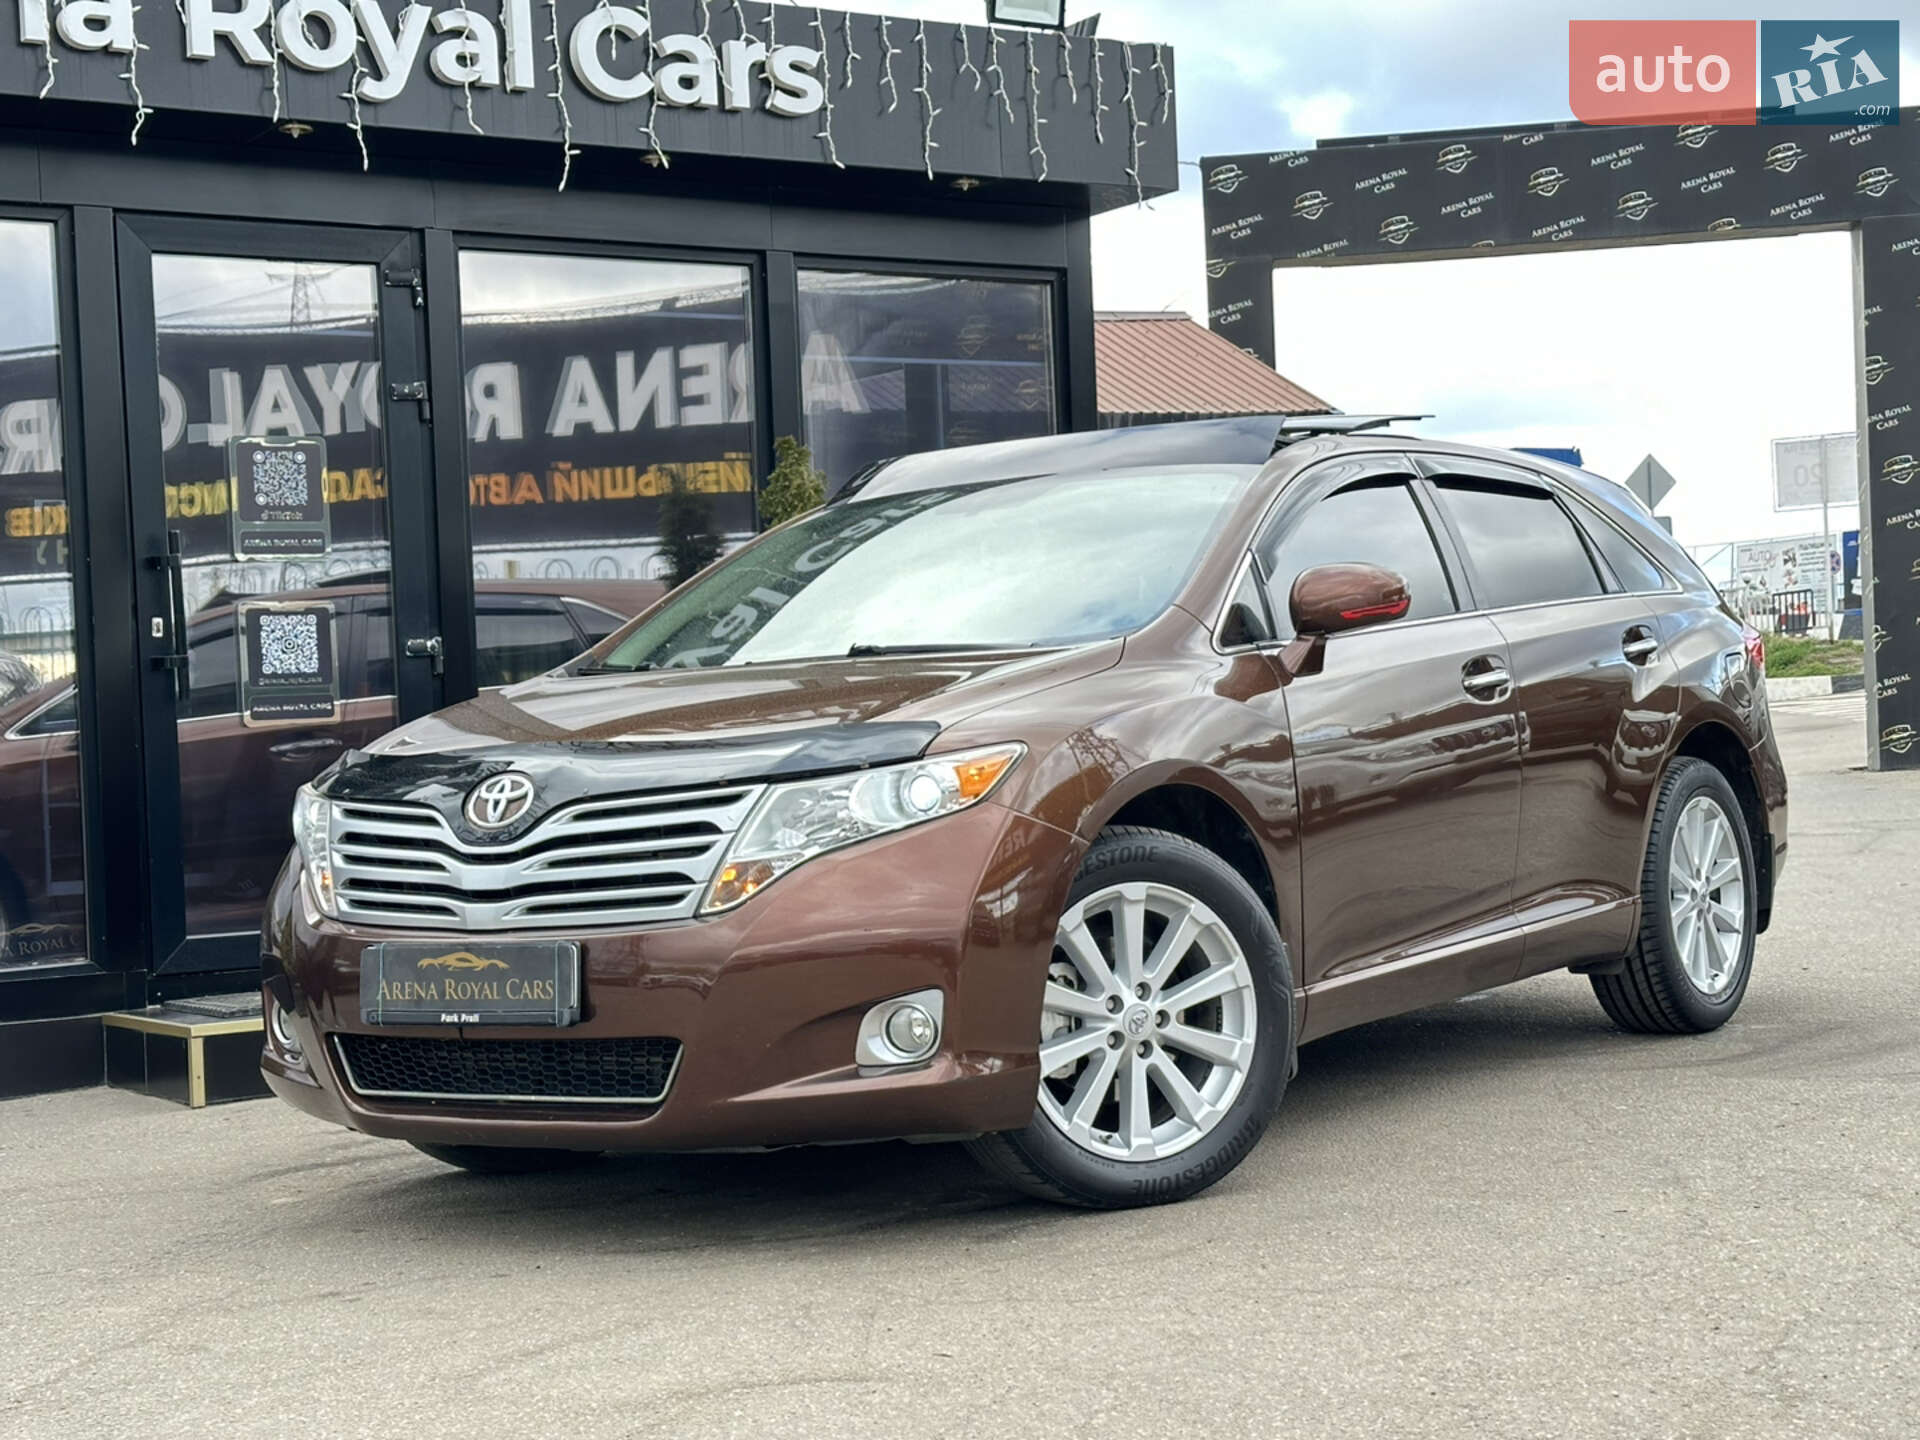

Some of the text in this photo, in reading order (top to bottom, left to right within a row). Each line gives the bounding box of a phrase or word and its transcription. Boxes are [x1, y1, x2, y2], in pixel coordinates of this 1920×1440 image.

[180, 0, 535, 102] Royal
[569, 4, 827, 117] Cars
[1829, 129, 1857, 143] ARENA
[1849, 133, 1872, 146] CARS
[1590, 143, 1645, 167] ARENA ROYAL
[1610, 157, 1633, 170] CARS
[1354, 168, 1408, 191] ARENA ROYAL
[1680, 166, 1736, 191] ARENA ROYAL
[1700, 181, 1723, 193] CARS
[1374, 182, 1396, 194] CARS
[1440, 192, 1494, 215] ARENA ROYAL
[1460, 206, 1482, 218] CARS
[1769, 193, 1825, 217] ARENA ROYAL
[1790, 207, 1813, 220] CARS
[1211, 214, 1263, 236] ARENA ROYAL
[1230, 227, 1253, 239] CARS
[1532, 215, 1586, 238] ARENA ROYAL
[1551, 229, 1574, 241] CARS
[377, 977, 554, 1001] ARENA ROYAL CARS
